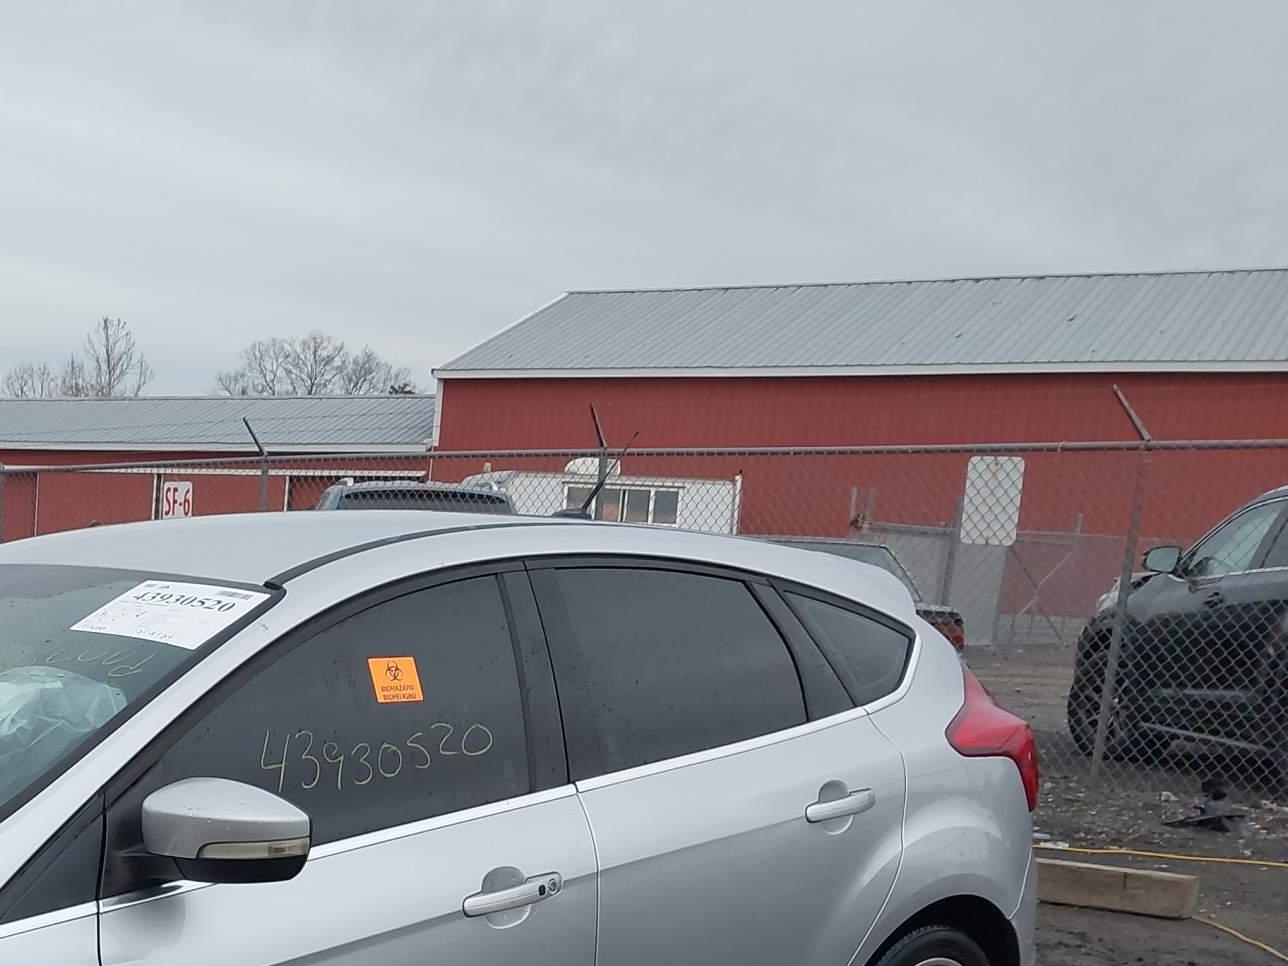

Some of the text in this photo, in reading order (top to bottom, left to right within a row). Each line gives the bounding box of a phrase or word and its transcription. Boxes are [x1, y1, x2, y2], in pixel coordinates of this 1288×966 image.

[164, 487, 191, 516] SF-6
[132, 590, 237, 613] 43930520
[261, 722, 494, 793] 43930520
